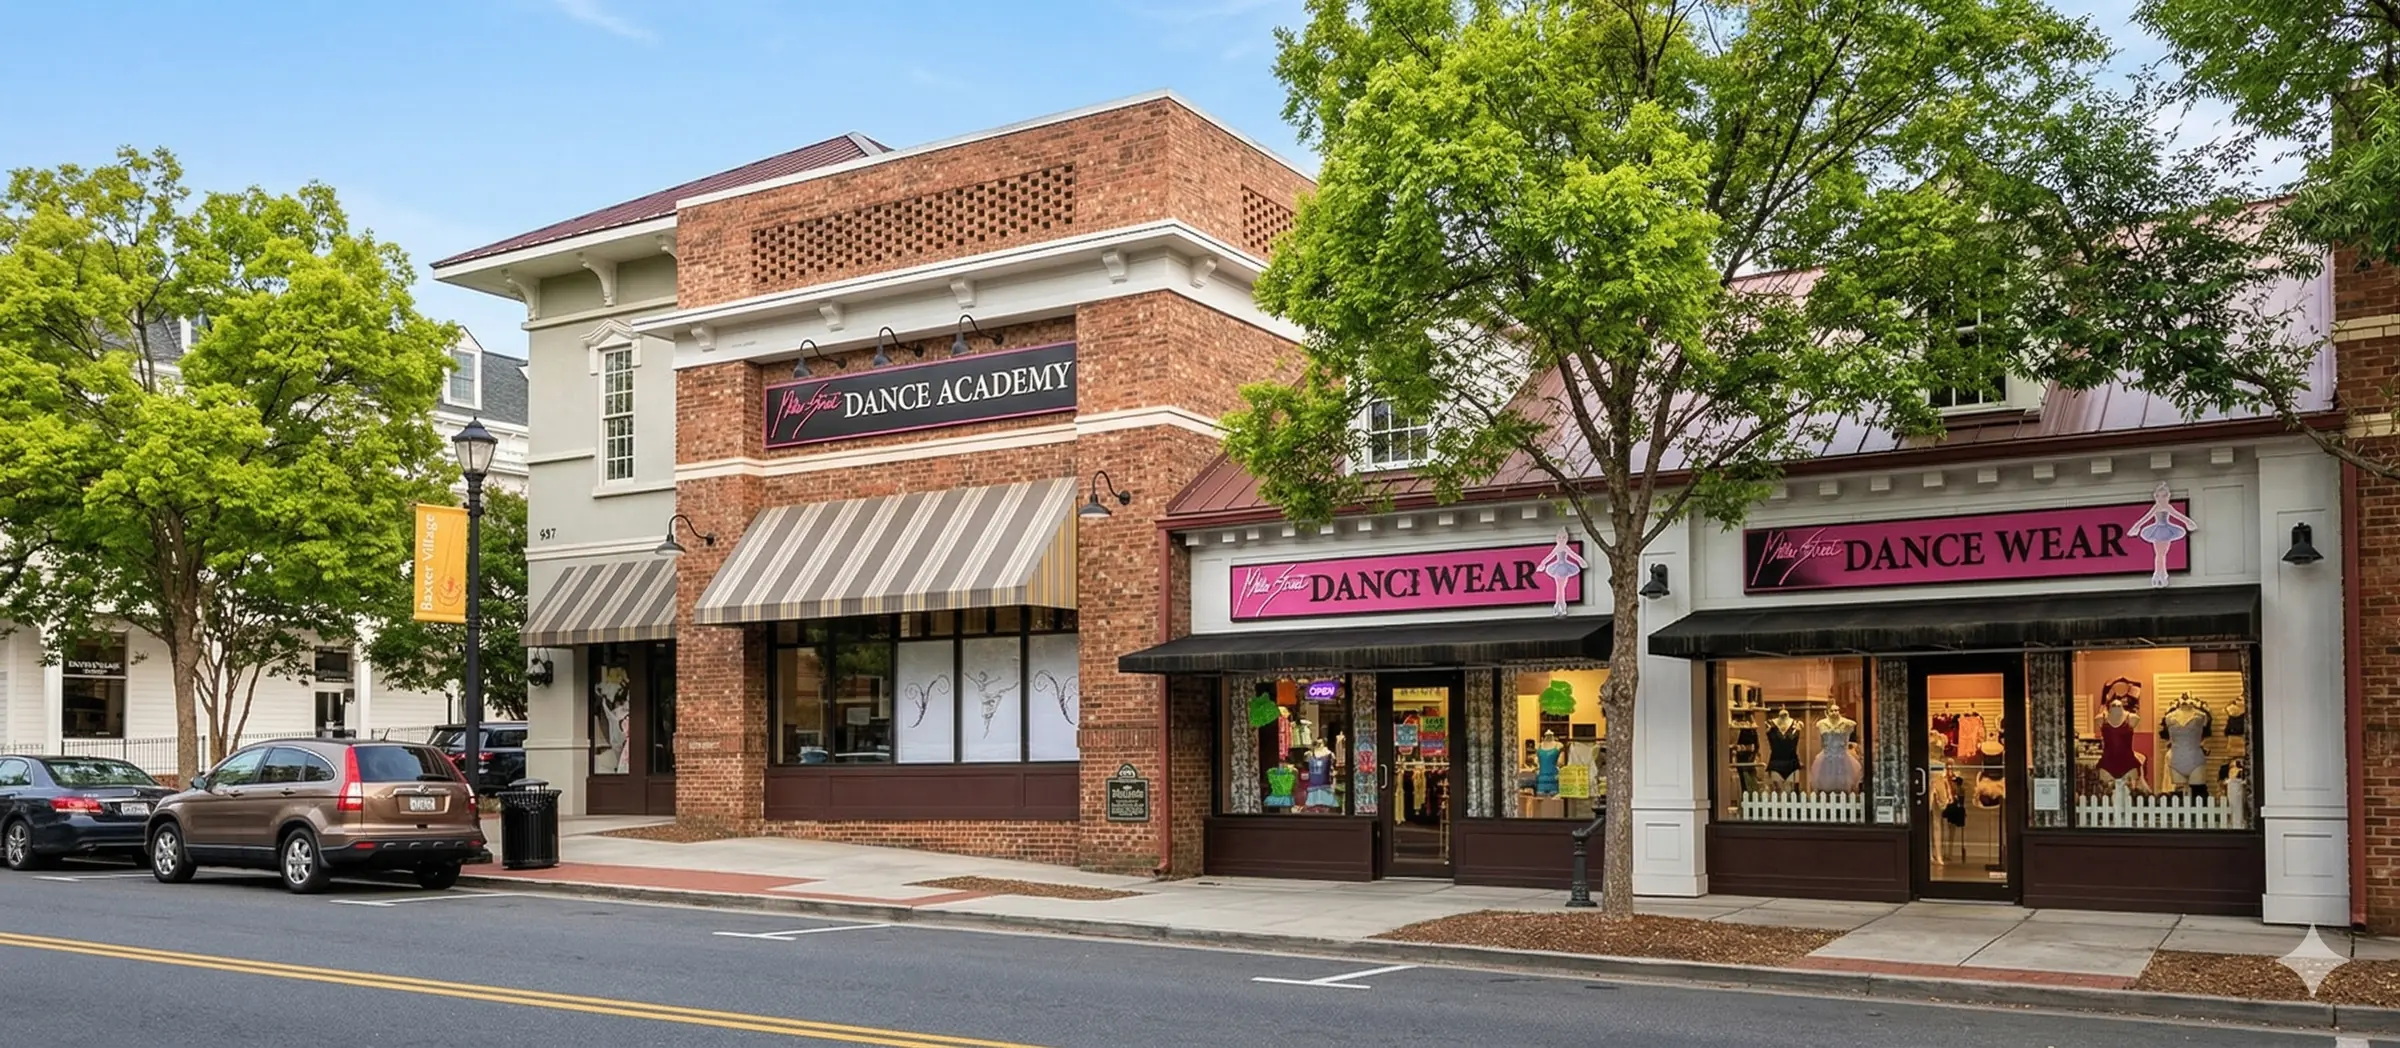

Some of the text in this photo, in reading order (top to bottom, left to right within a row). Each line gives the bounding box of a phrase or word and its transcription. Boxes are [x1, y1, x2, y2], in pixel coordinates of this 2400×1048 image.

[844, 381, 932, 419] DANCE
[937, 360, 1073, 407] ACADEMY
[420, 513, 438, 611] Baxter Village
[1843, 531, 1985, 572] DANCE
[1994, 522, 2129, 563] WEAR
[1424, 559, 1540, 595] WEAR
[1308, 685, 1336, 697] OPEN
